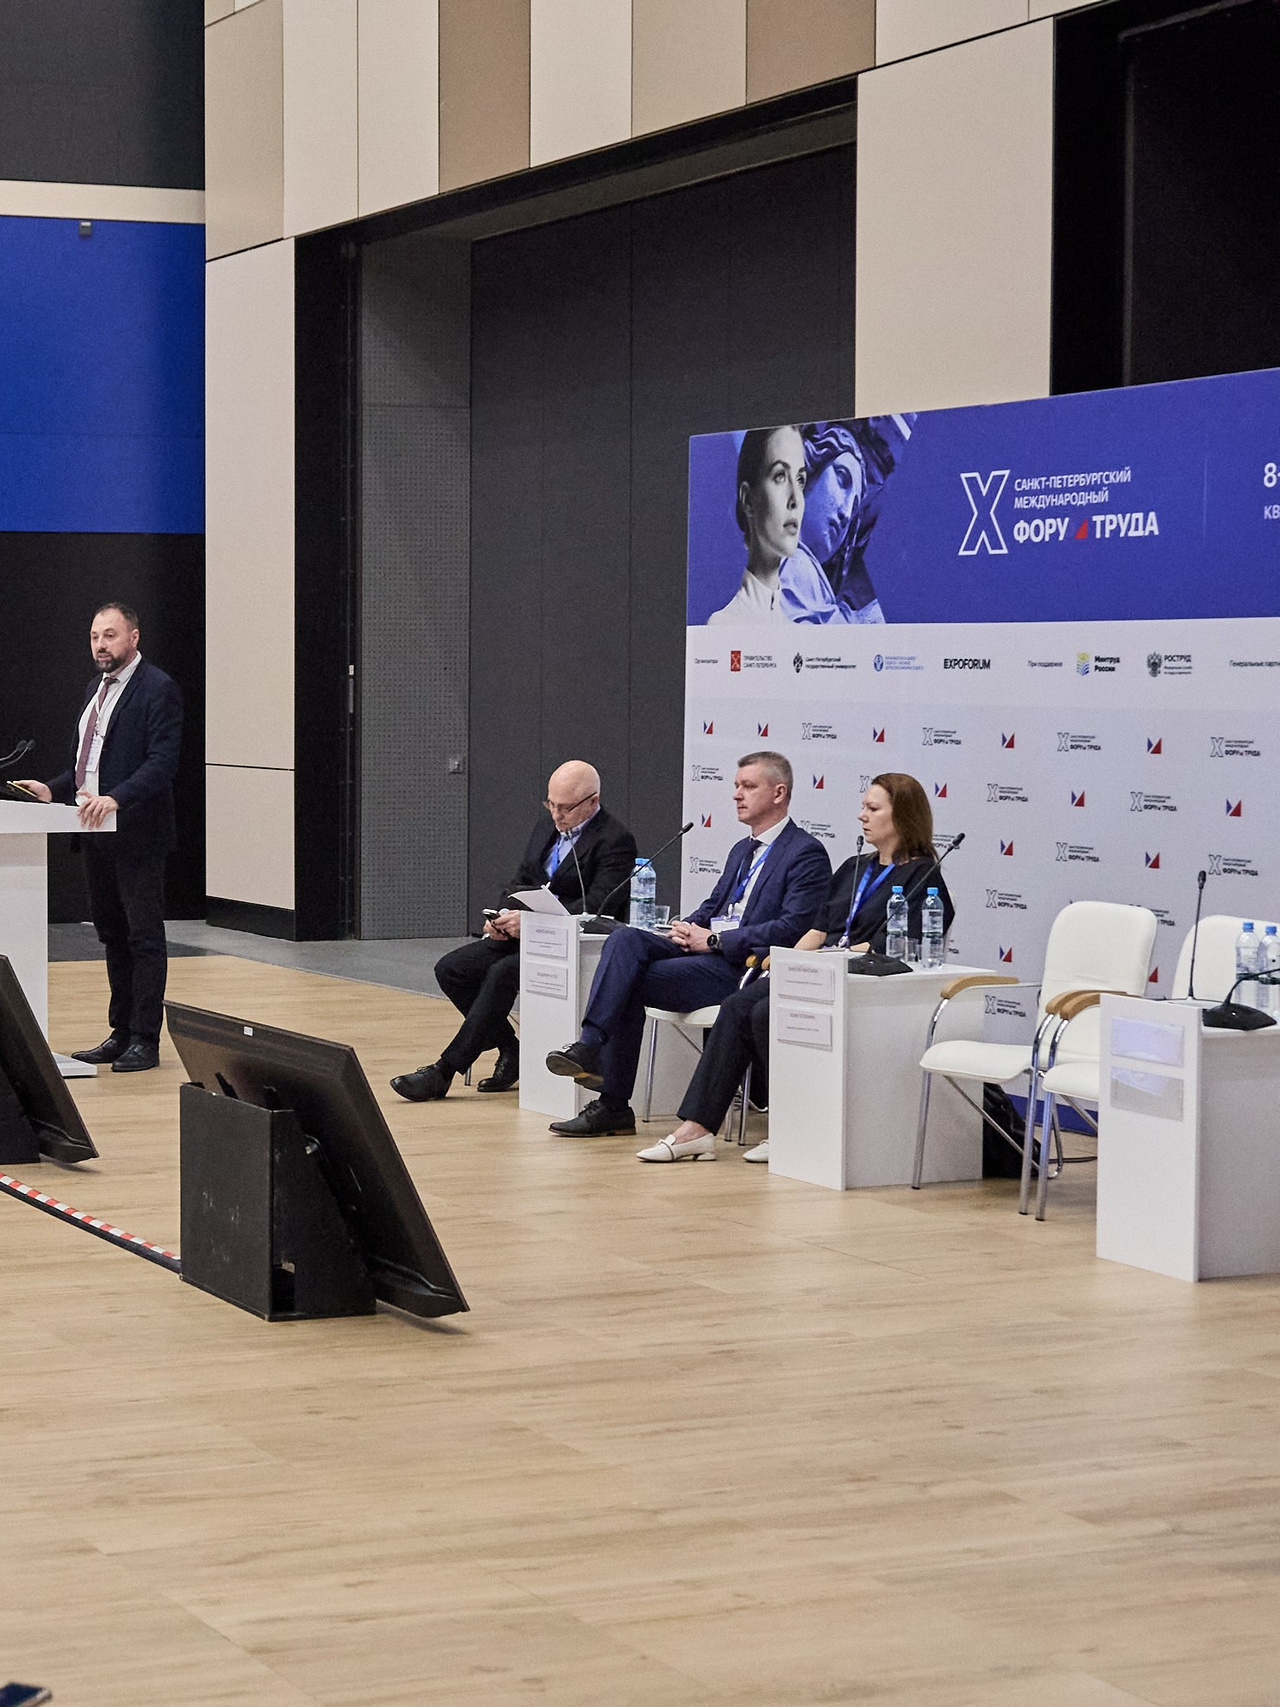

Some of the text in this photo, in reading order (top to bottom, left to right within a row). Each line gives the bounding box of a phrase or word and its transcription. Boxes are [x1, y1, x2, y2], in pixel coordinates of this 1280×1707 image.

[1014, 466, 1131, 492] САНКТ-ПЕТЕРБУРГСКИЙ
[1263, 462, 1280, 488] 8
[1014, 487, 1109, 509] МЕЖДУНАРОДНЫЙ
[1092, 511, 1159, 539] ТРУДА
[943, 658, 990, 670] EXPOFORUM
[1094, 656, 1120, 665] Минтруд
[1164, 654, 1192, 663] РОСТРУД
